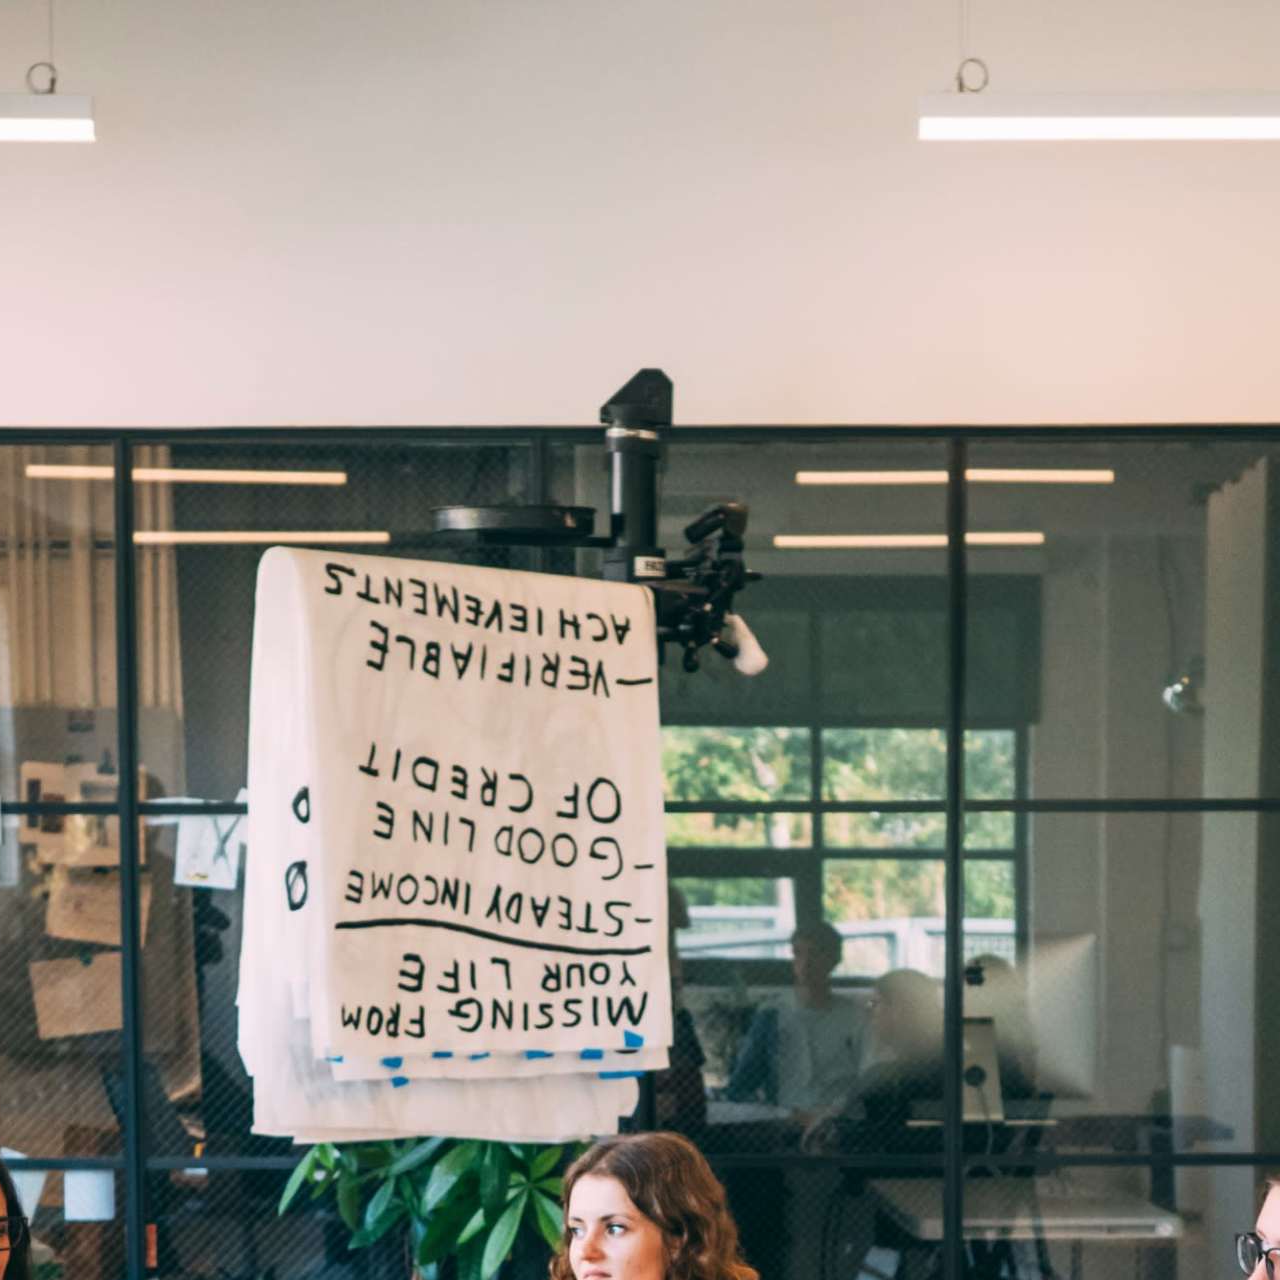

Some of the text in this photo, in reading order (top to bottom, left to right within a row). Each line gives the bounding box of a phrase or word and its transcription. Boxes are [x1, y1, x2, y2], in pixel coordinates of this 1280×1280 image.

[323, 562, 632, 644] ACHIEVEMENTS
[358, 742, 534, 813] CREDIT
[556, 777, 622, 824] OF
[372, 802, 476, 852] LINE
[344, 870, 471, 915] INCOME
[397, 953, 637, 993] YOUR LIFE
[341, 992, 649, 1039] MISSING FROM
